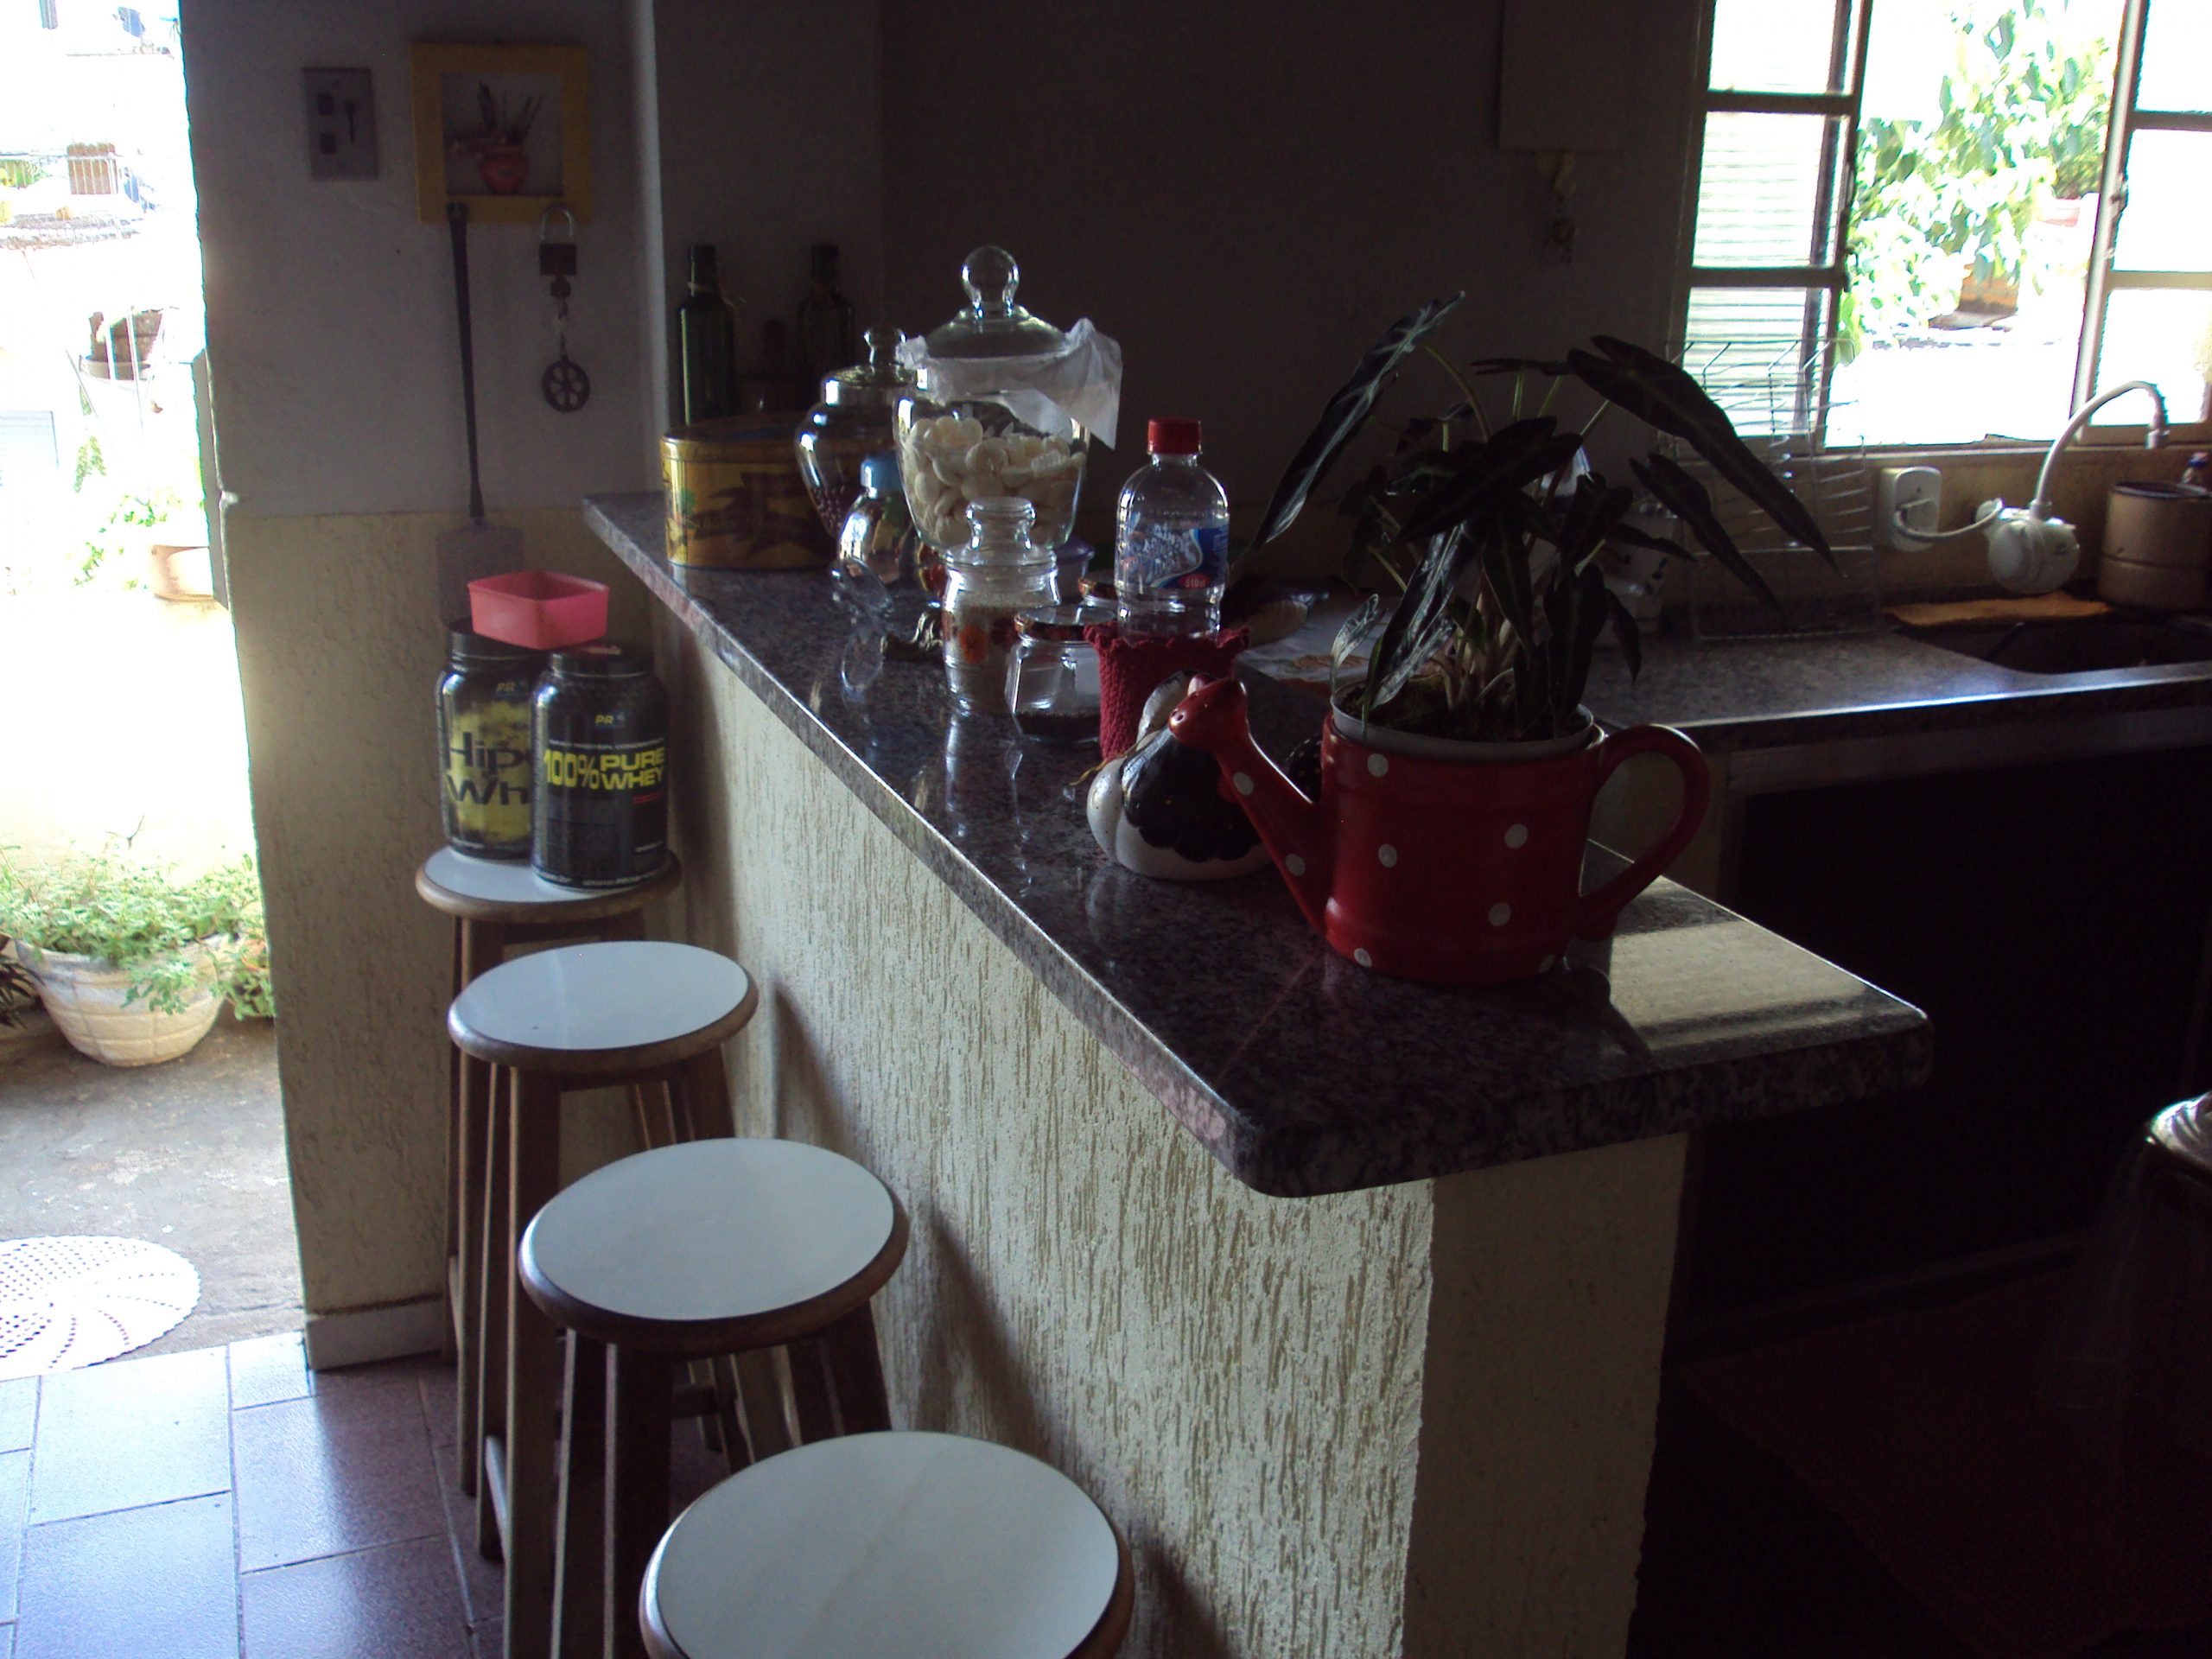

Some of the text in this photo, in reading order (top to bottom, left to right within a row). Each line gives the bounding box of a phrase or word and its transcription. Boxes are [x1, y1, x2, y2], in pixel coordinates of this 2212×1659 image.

[543, 746, 665, 790] 100% PURE
[600, 765, 664, 791] WHEY
